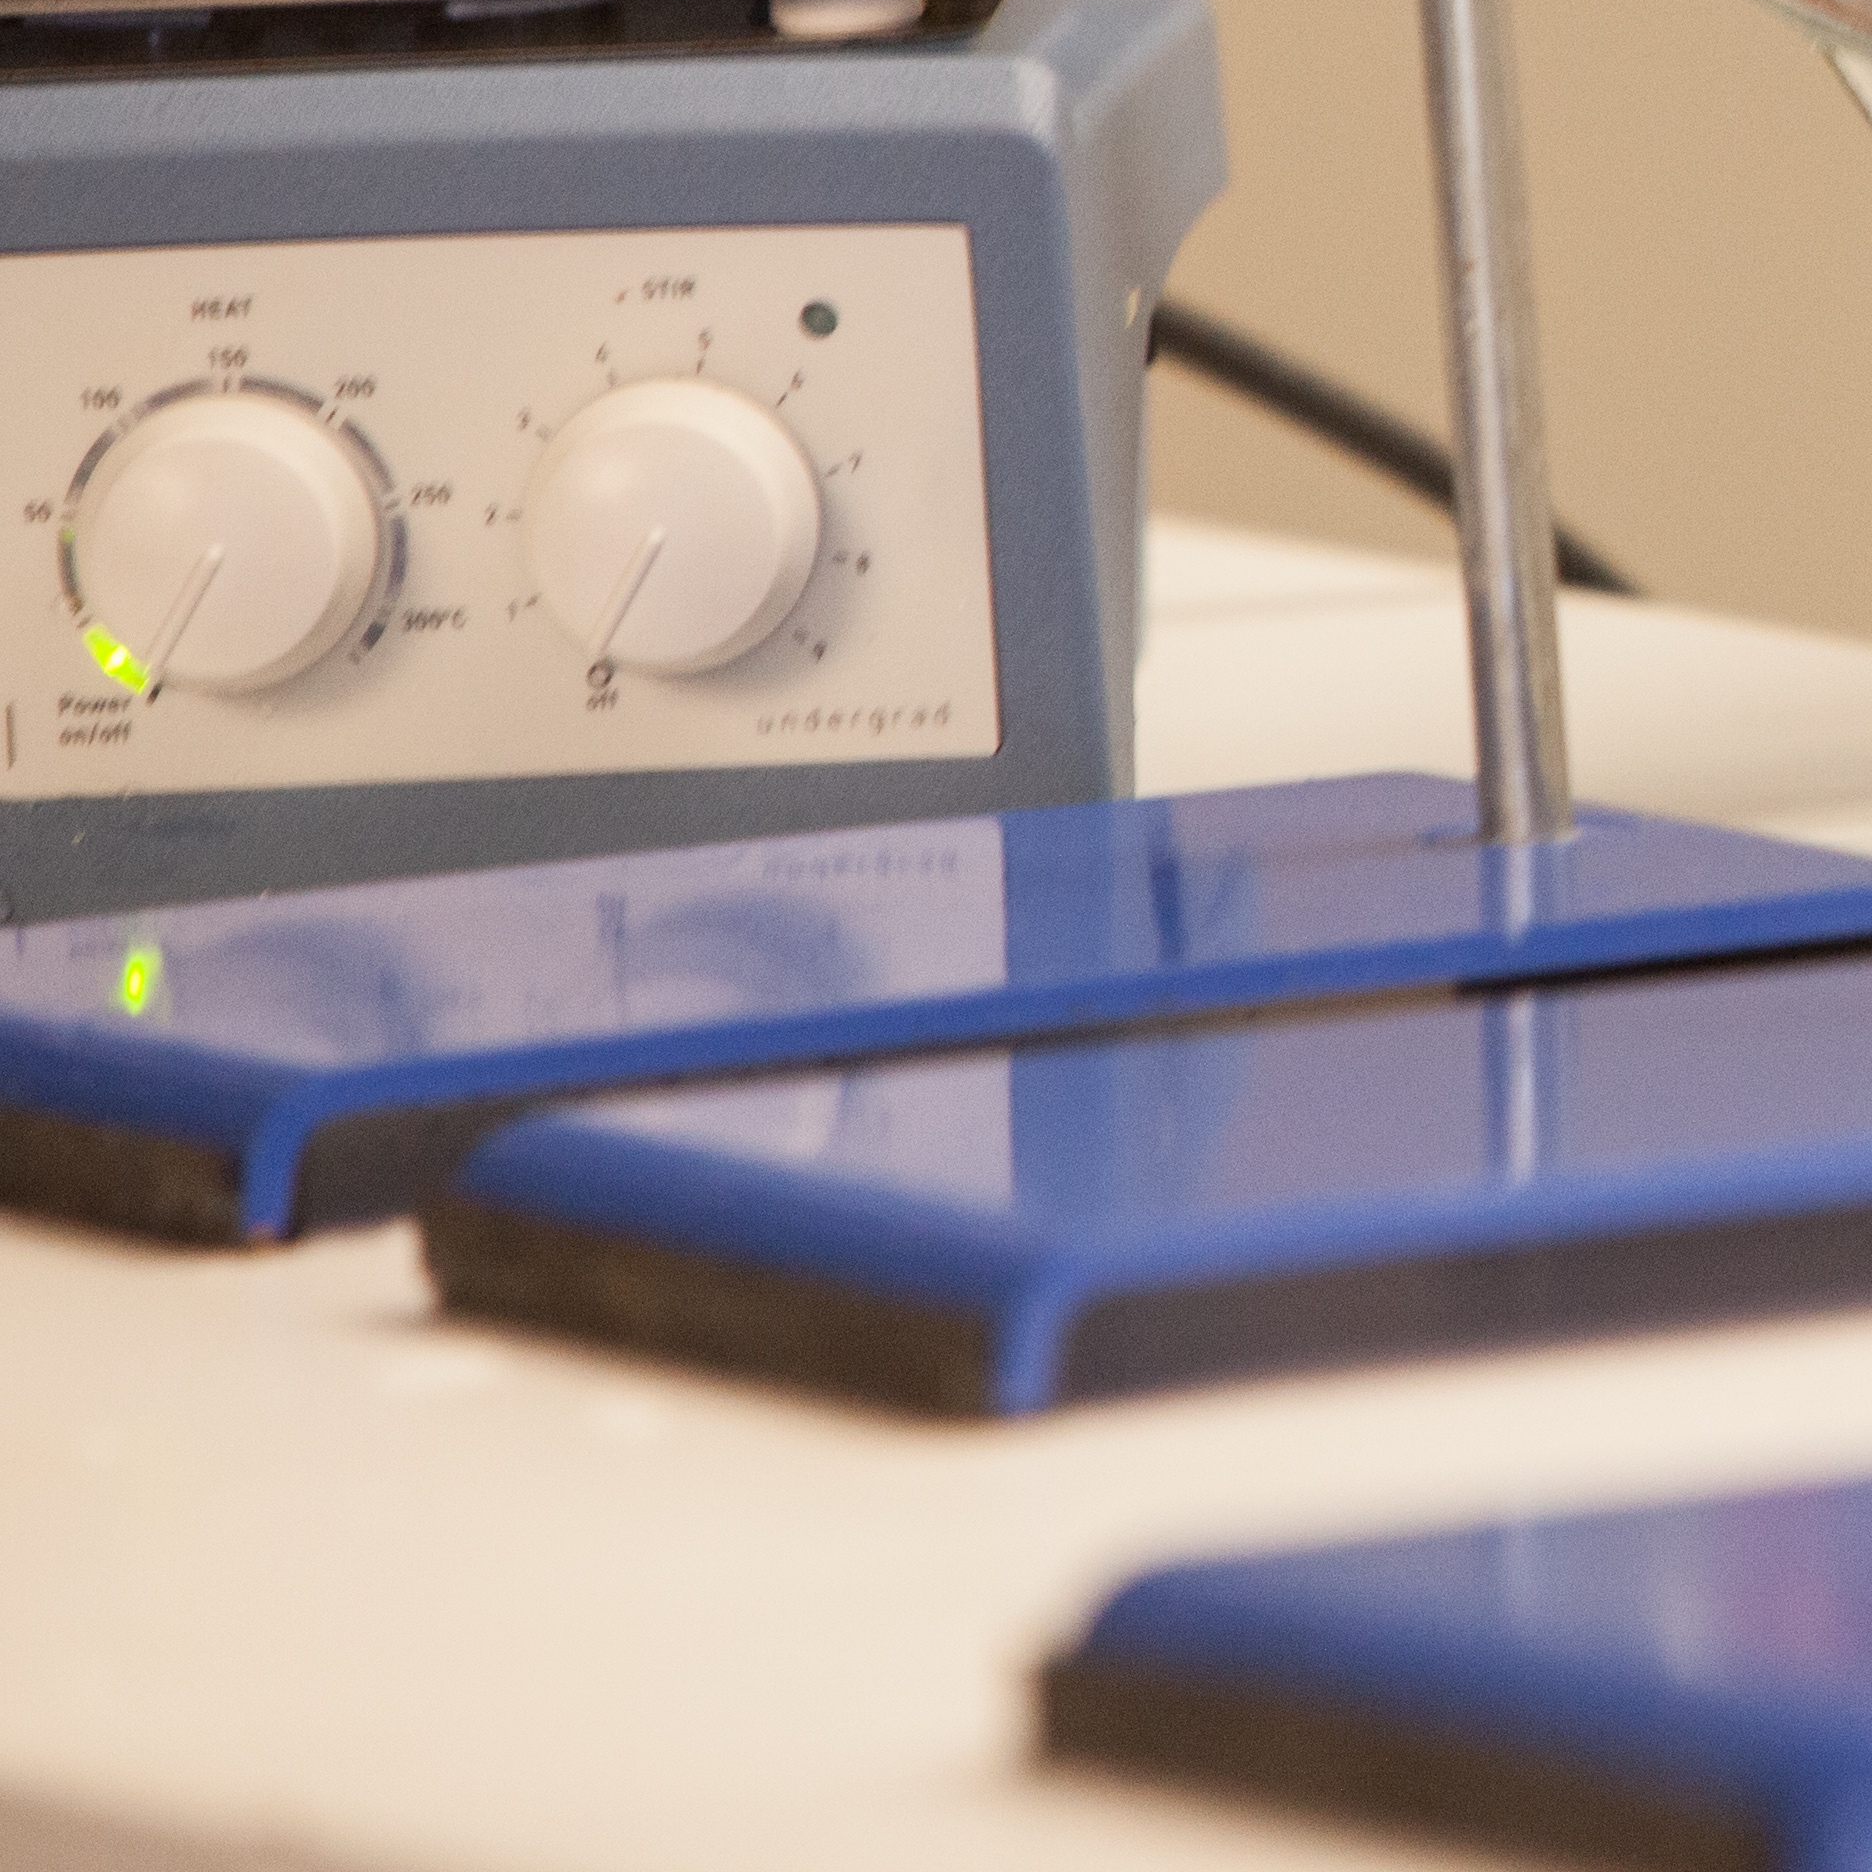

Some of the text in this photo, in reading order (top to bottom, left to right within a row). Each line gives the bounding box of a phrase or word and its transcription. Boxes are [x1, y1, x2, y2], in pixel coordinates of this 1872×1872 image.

[640, 275, 697, 300] STIR
[190, 295, 254, 321] HEAT
[207, 345, 249, 369] 150
[80, 385, 123, 410] 100
[333, 374, 377, 400] 200
[410, 482, 452, 507] 250
[23, 498, 54, 523] 50
[57, 690, 133, 718] Power
[585, 687, 619, 712] off
[756, 700, 953, 737] undergrad
[58, 720, 132, 747] on/off
